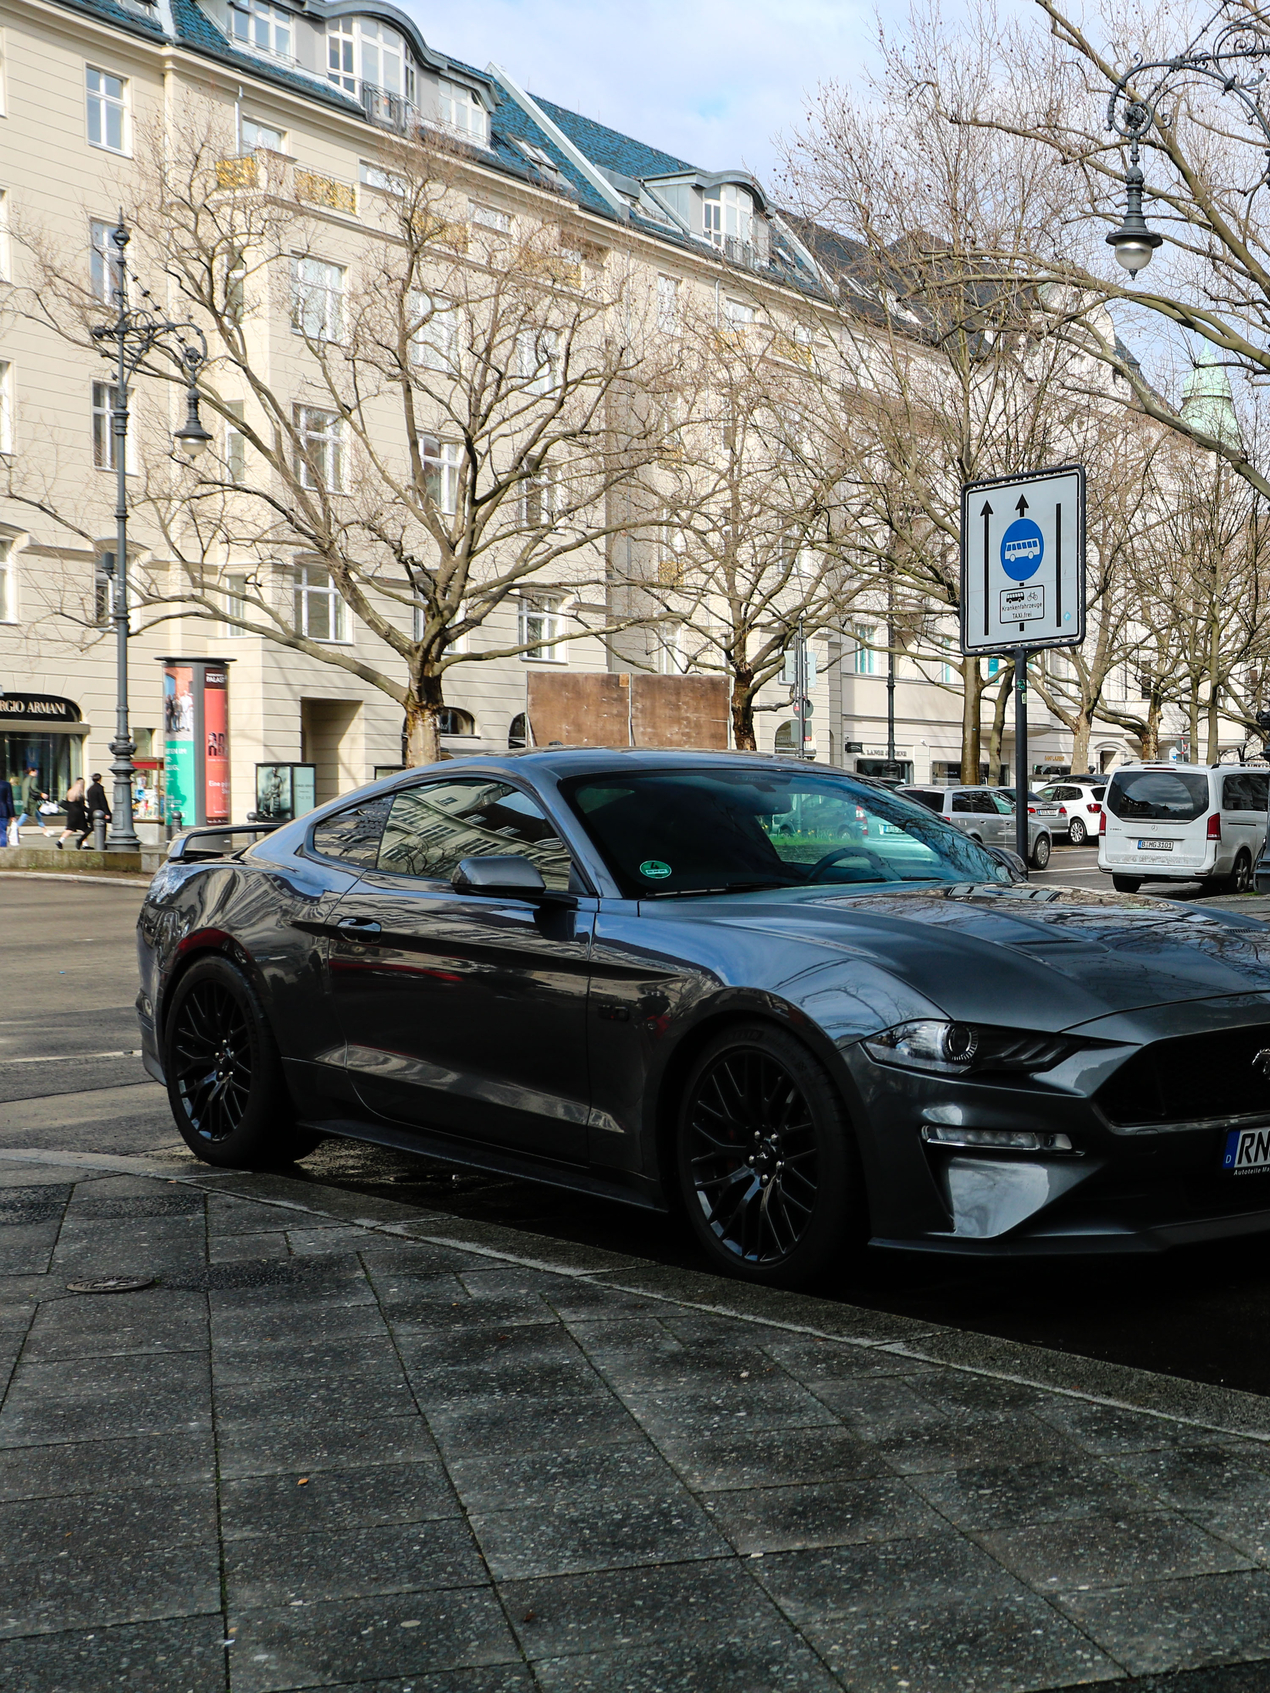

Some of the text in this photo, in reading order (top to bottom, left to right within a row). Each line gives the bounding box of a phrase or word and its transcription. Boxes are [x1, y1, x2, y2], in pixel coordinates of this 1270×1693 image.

[1002, 602, 1042, 612] Krankenfahrzeuge
[27, 702, 66, 715] ARMANI
[1225, 1154, 1232, 1164] D
[1233, 1167, 1261, 1176] Autoteile
